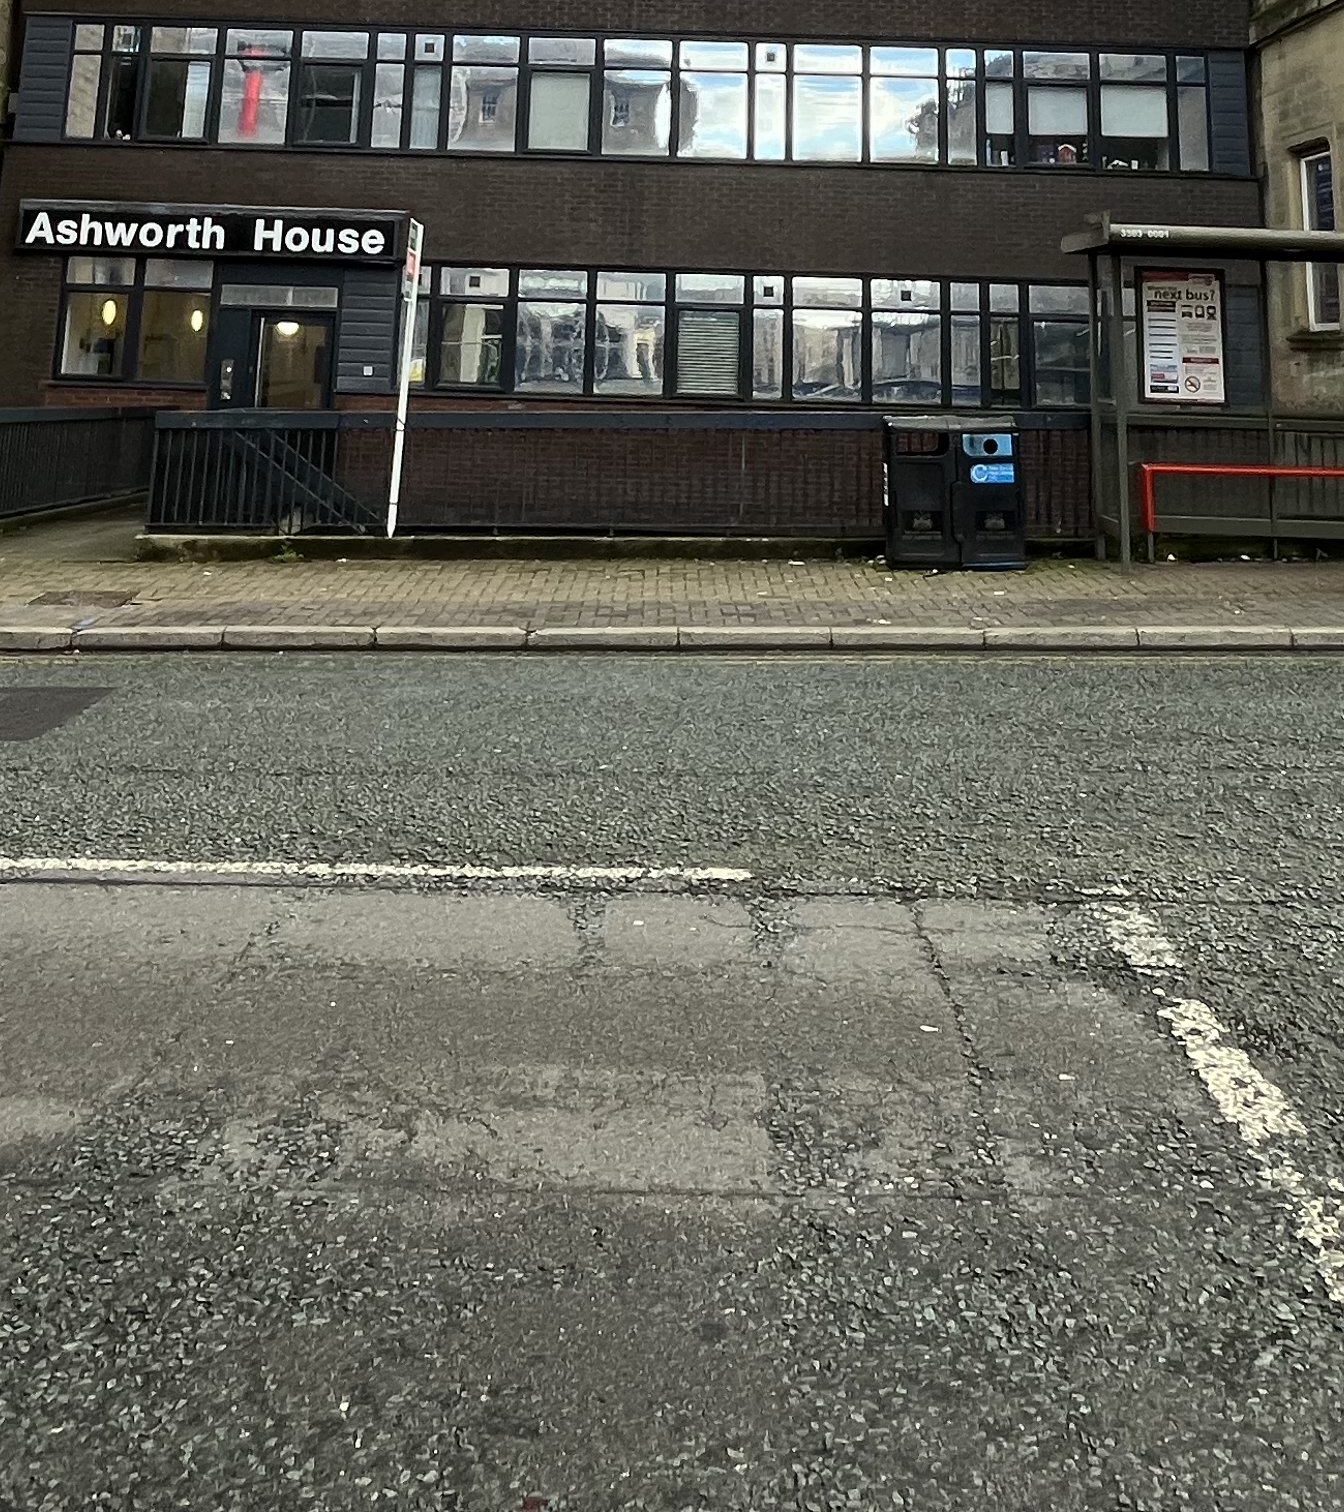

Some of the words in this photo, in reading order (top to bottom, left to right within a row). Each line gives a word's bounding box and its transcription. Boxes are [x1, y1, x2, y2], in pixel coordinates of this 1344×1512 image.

[25, 211, 225, 251] Ashworth
[253, 218, 386, 255] House
[1154, 289, 1182, 301] next
[1185, 288, 1216, 301] bus?
